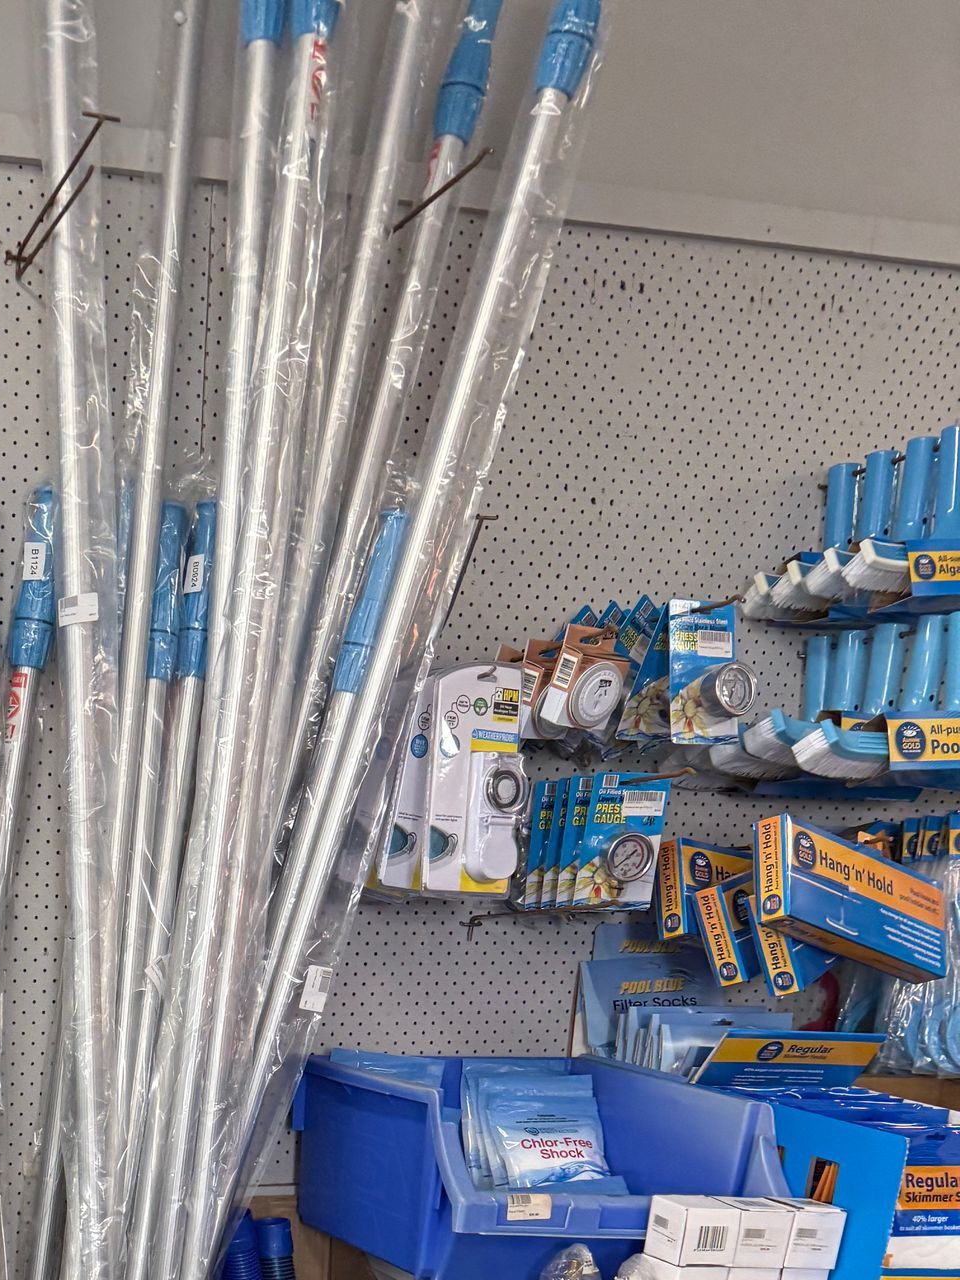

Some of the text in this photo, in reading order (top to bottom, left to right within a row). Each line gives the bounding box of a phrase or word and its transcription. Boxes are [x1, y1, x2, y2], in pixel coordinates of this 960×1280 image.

[30, 548, 40, 576] B1124
[503, 689, 519, 701] HPM
[931, 739, 960, 754] Poo
[594, 813, 626, 825] GAUGE
[761, 823, 772, 849] Hold
[662, 846, 670, 870] Hold
[764, 862, 774, 893] Hang
[818, 849, 850, 881] Hang
[867, 870, 894, 896] Hold
[664, 884, 675, 912] Hang
[701, 895, 713, 920] Hold
[712, 934, 726, 961] Hang
[767, 942, 781, 970] Hang
[620, 980, 651, 995] POOL
[613, 995, 697, 1011] Filter Socks
[787, 1044, 834, 1055] Regular
[520, 1136, 593, 1150] Chlor-Free
[540, 1148, 585, 1160] Shock
[905, 1172, 960, 1192] Regula
[905, 1191, 953, 1204] Skimmer
[928, 1215, 949, 1224] larger
